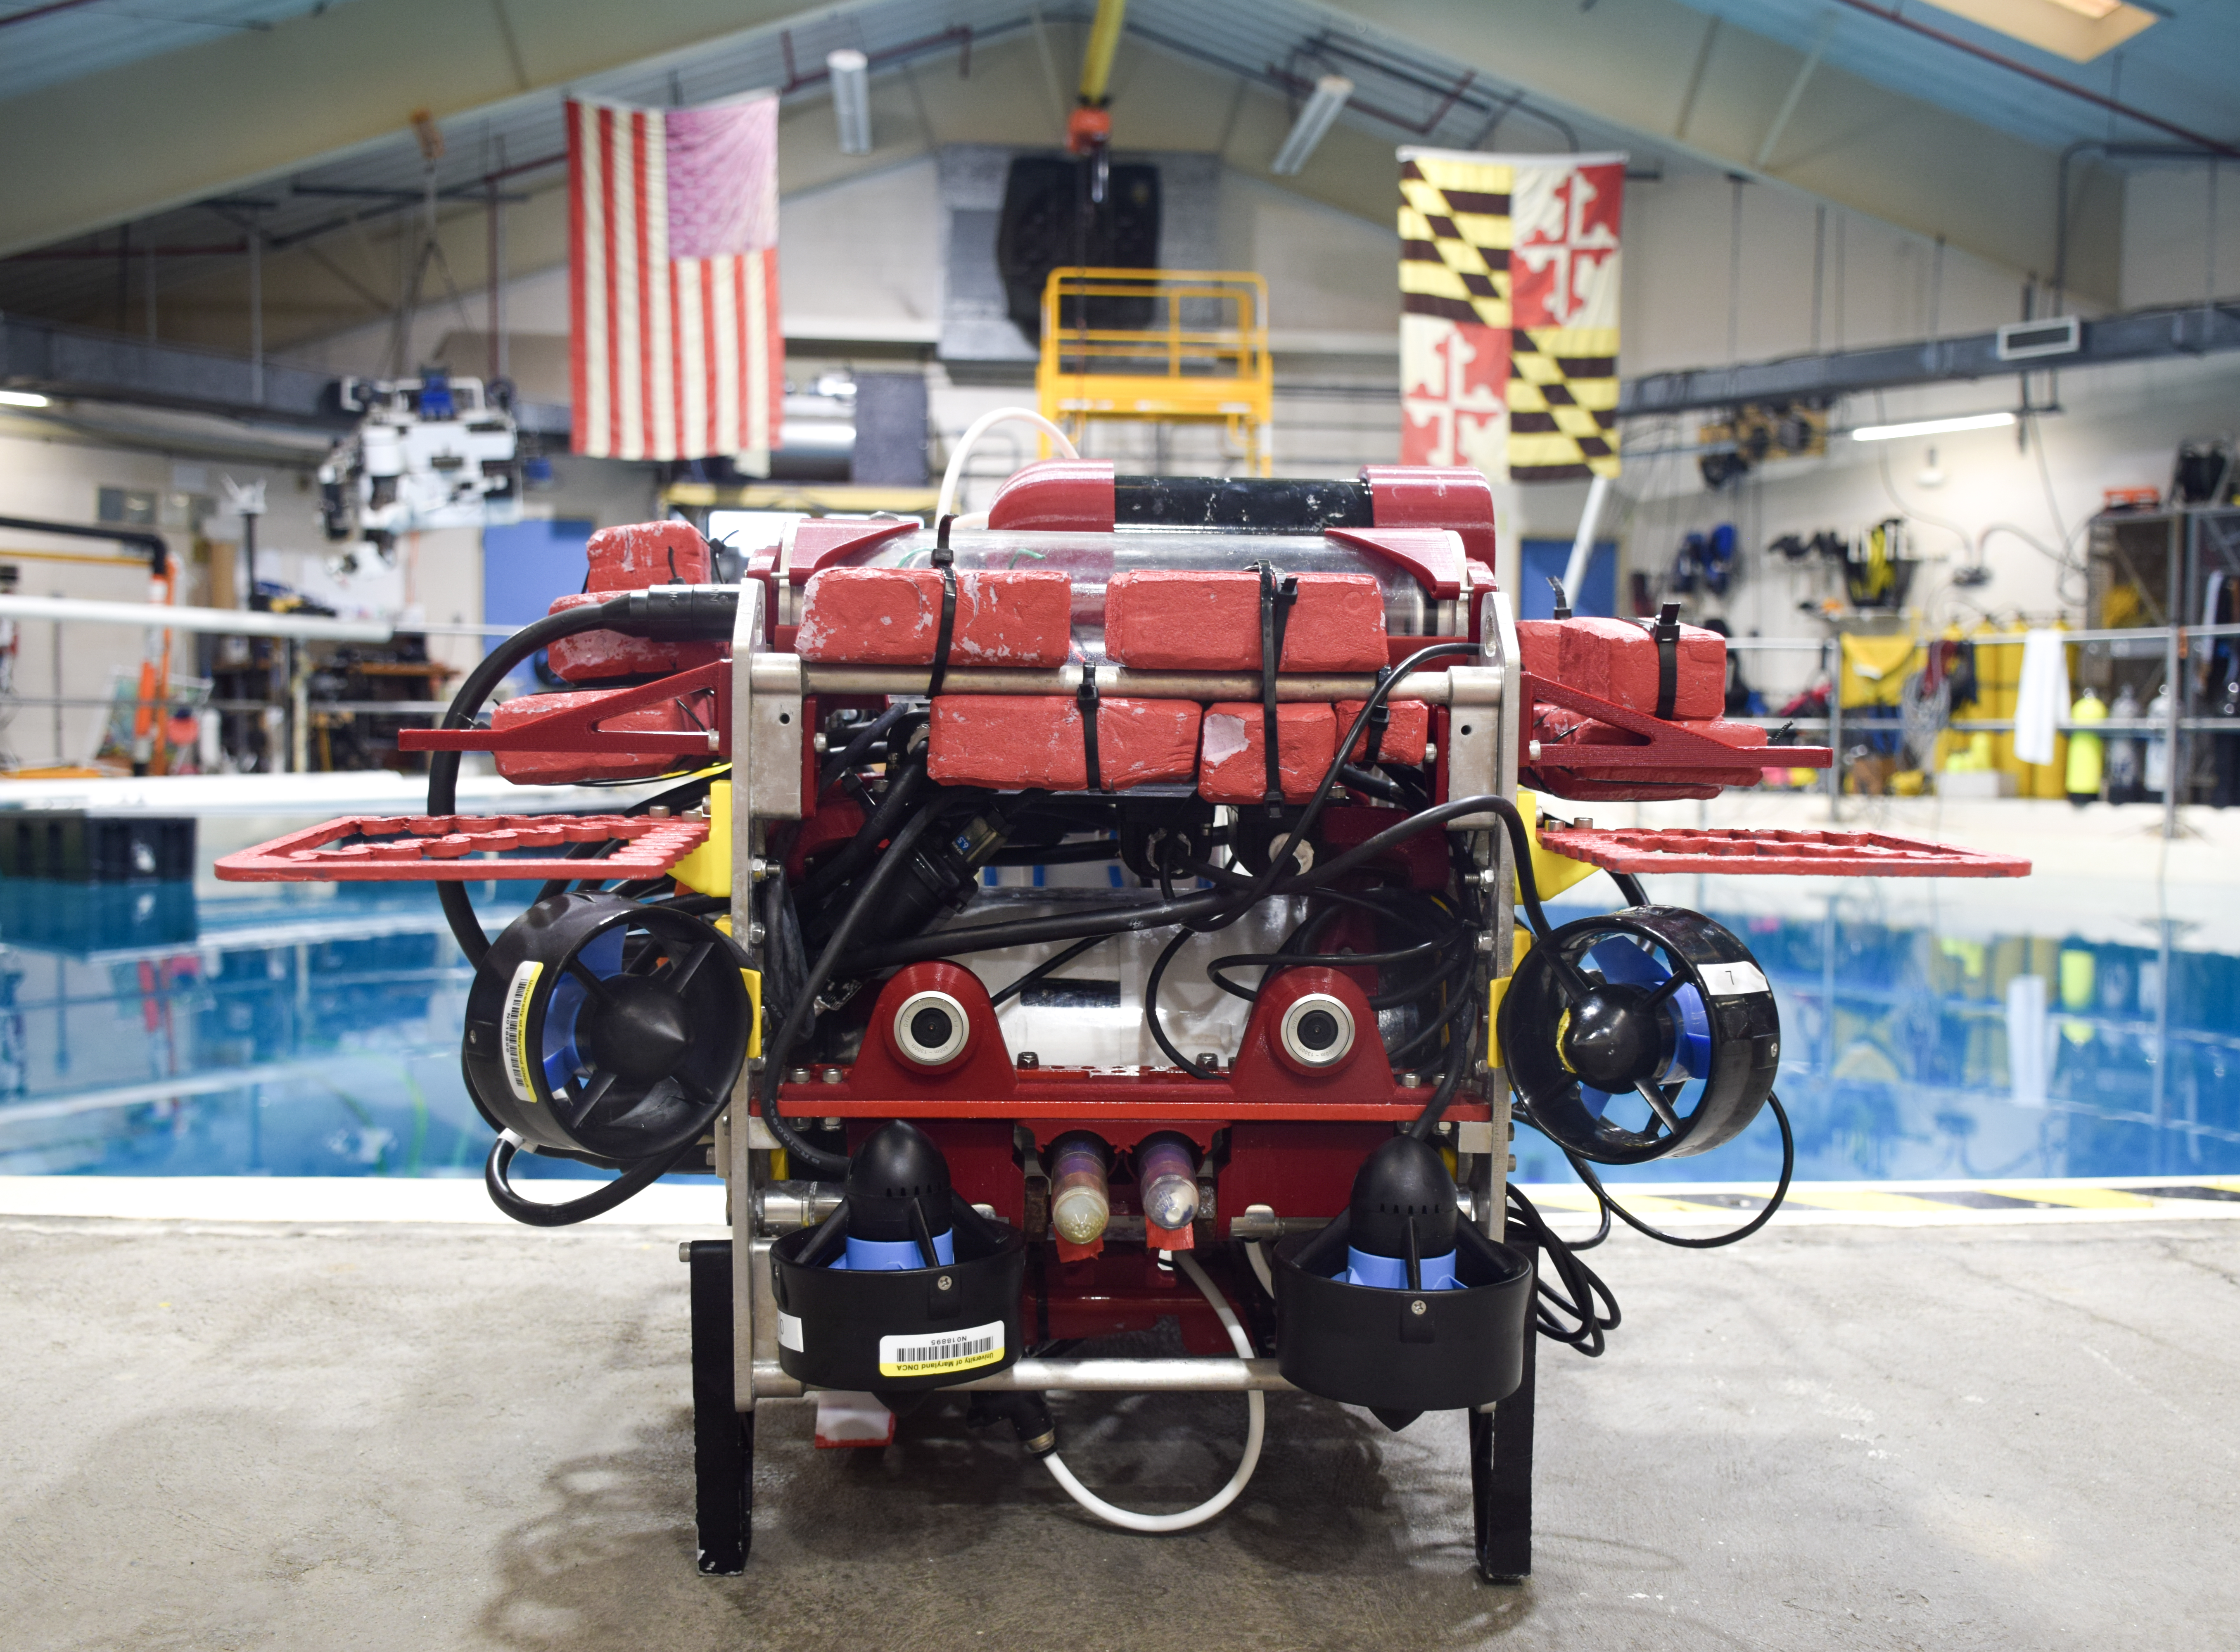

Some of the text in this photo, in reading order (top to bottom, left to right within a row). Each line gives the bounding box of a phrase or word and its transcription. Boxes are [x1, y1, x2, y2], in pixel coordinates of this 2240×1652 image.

[957, 836, 969, 849] 6.5
[1725, 971, 1735, 985] 7
[520, 980, 534, 1017] University
[911, 1043, 927, 1054] 1300ft
[1298, 1045, 1314, 1057] 1300ft
[931, 1336, 967, 1346] N018895
[965, 1353, 993, 1363] University
[921, 1361, 954, 1370] Maryland
